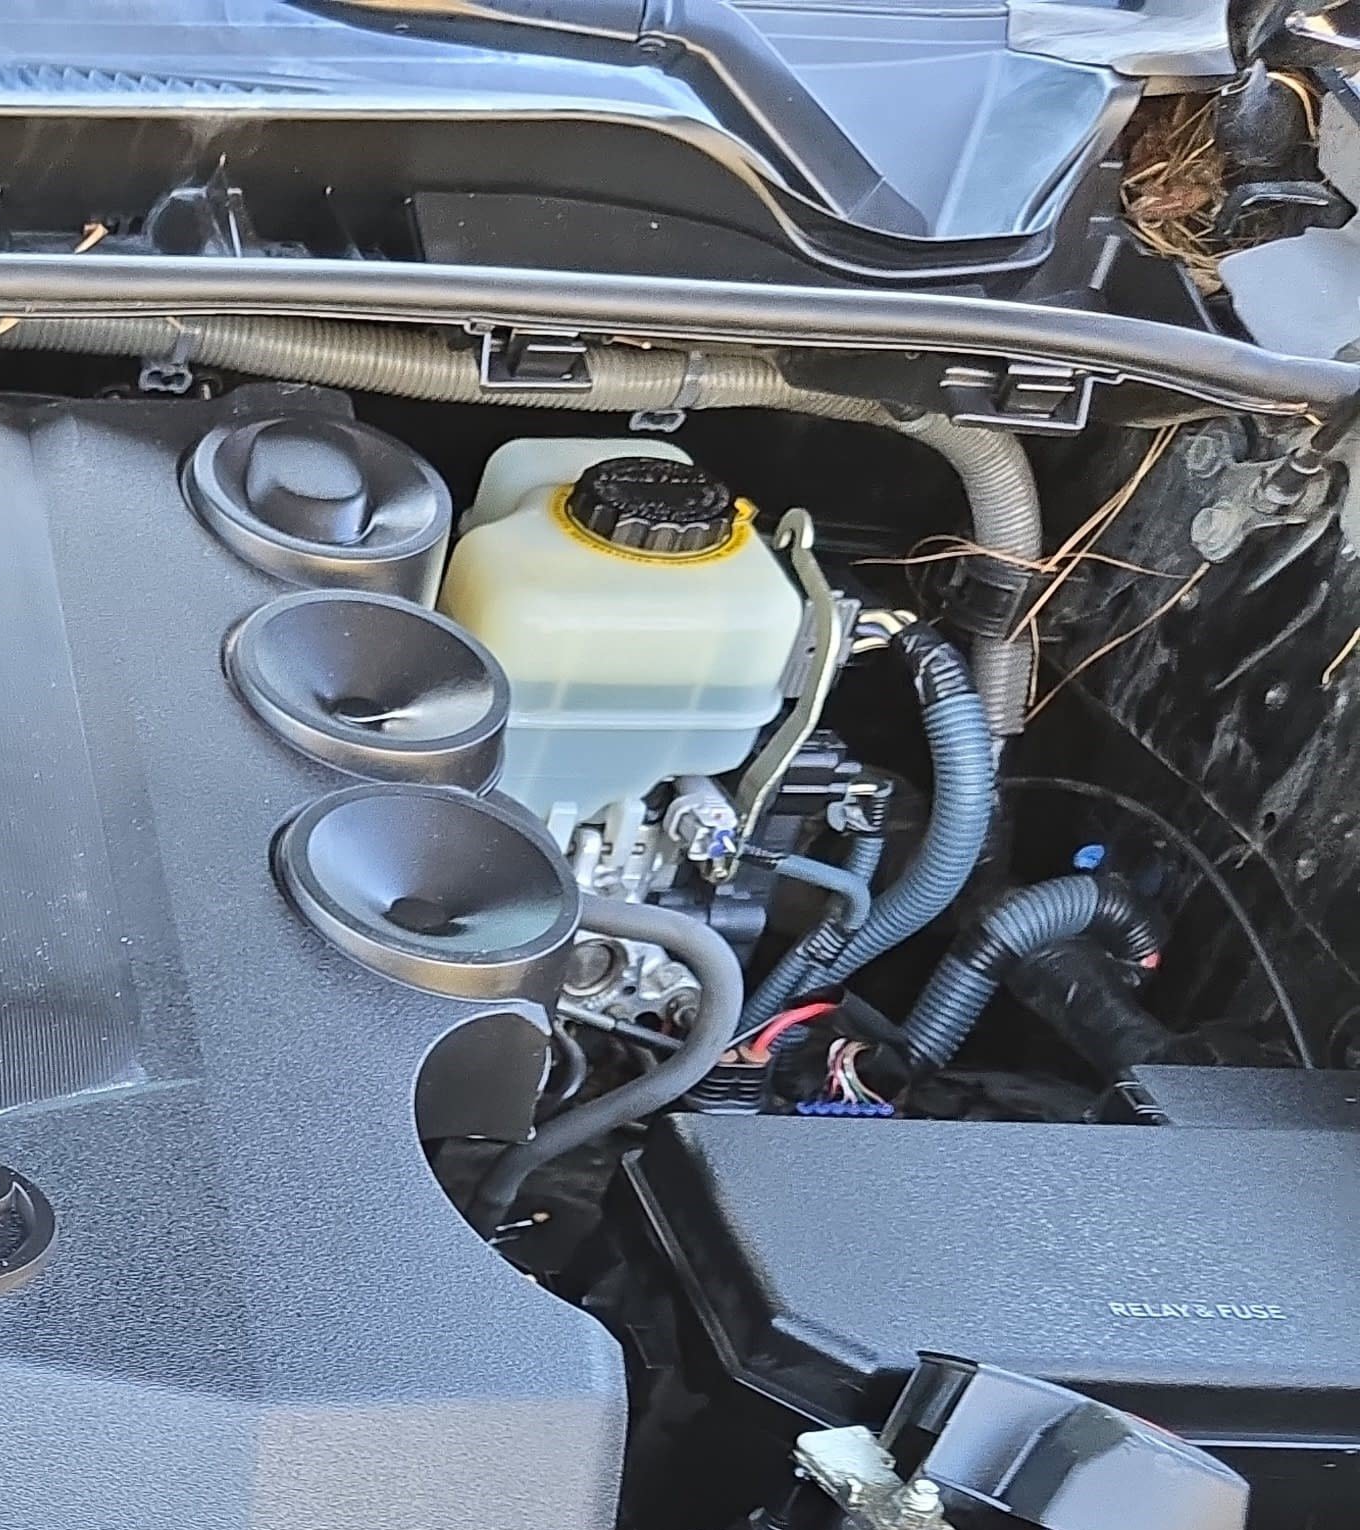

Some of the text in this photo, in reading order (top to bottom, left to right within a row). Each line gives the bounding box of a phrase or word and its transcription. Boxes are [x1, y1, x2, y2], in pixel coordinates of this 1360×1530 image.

[1109, 1302, 1287, 1320] RELAY & FUSE
